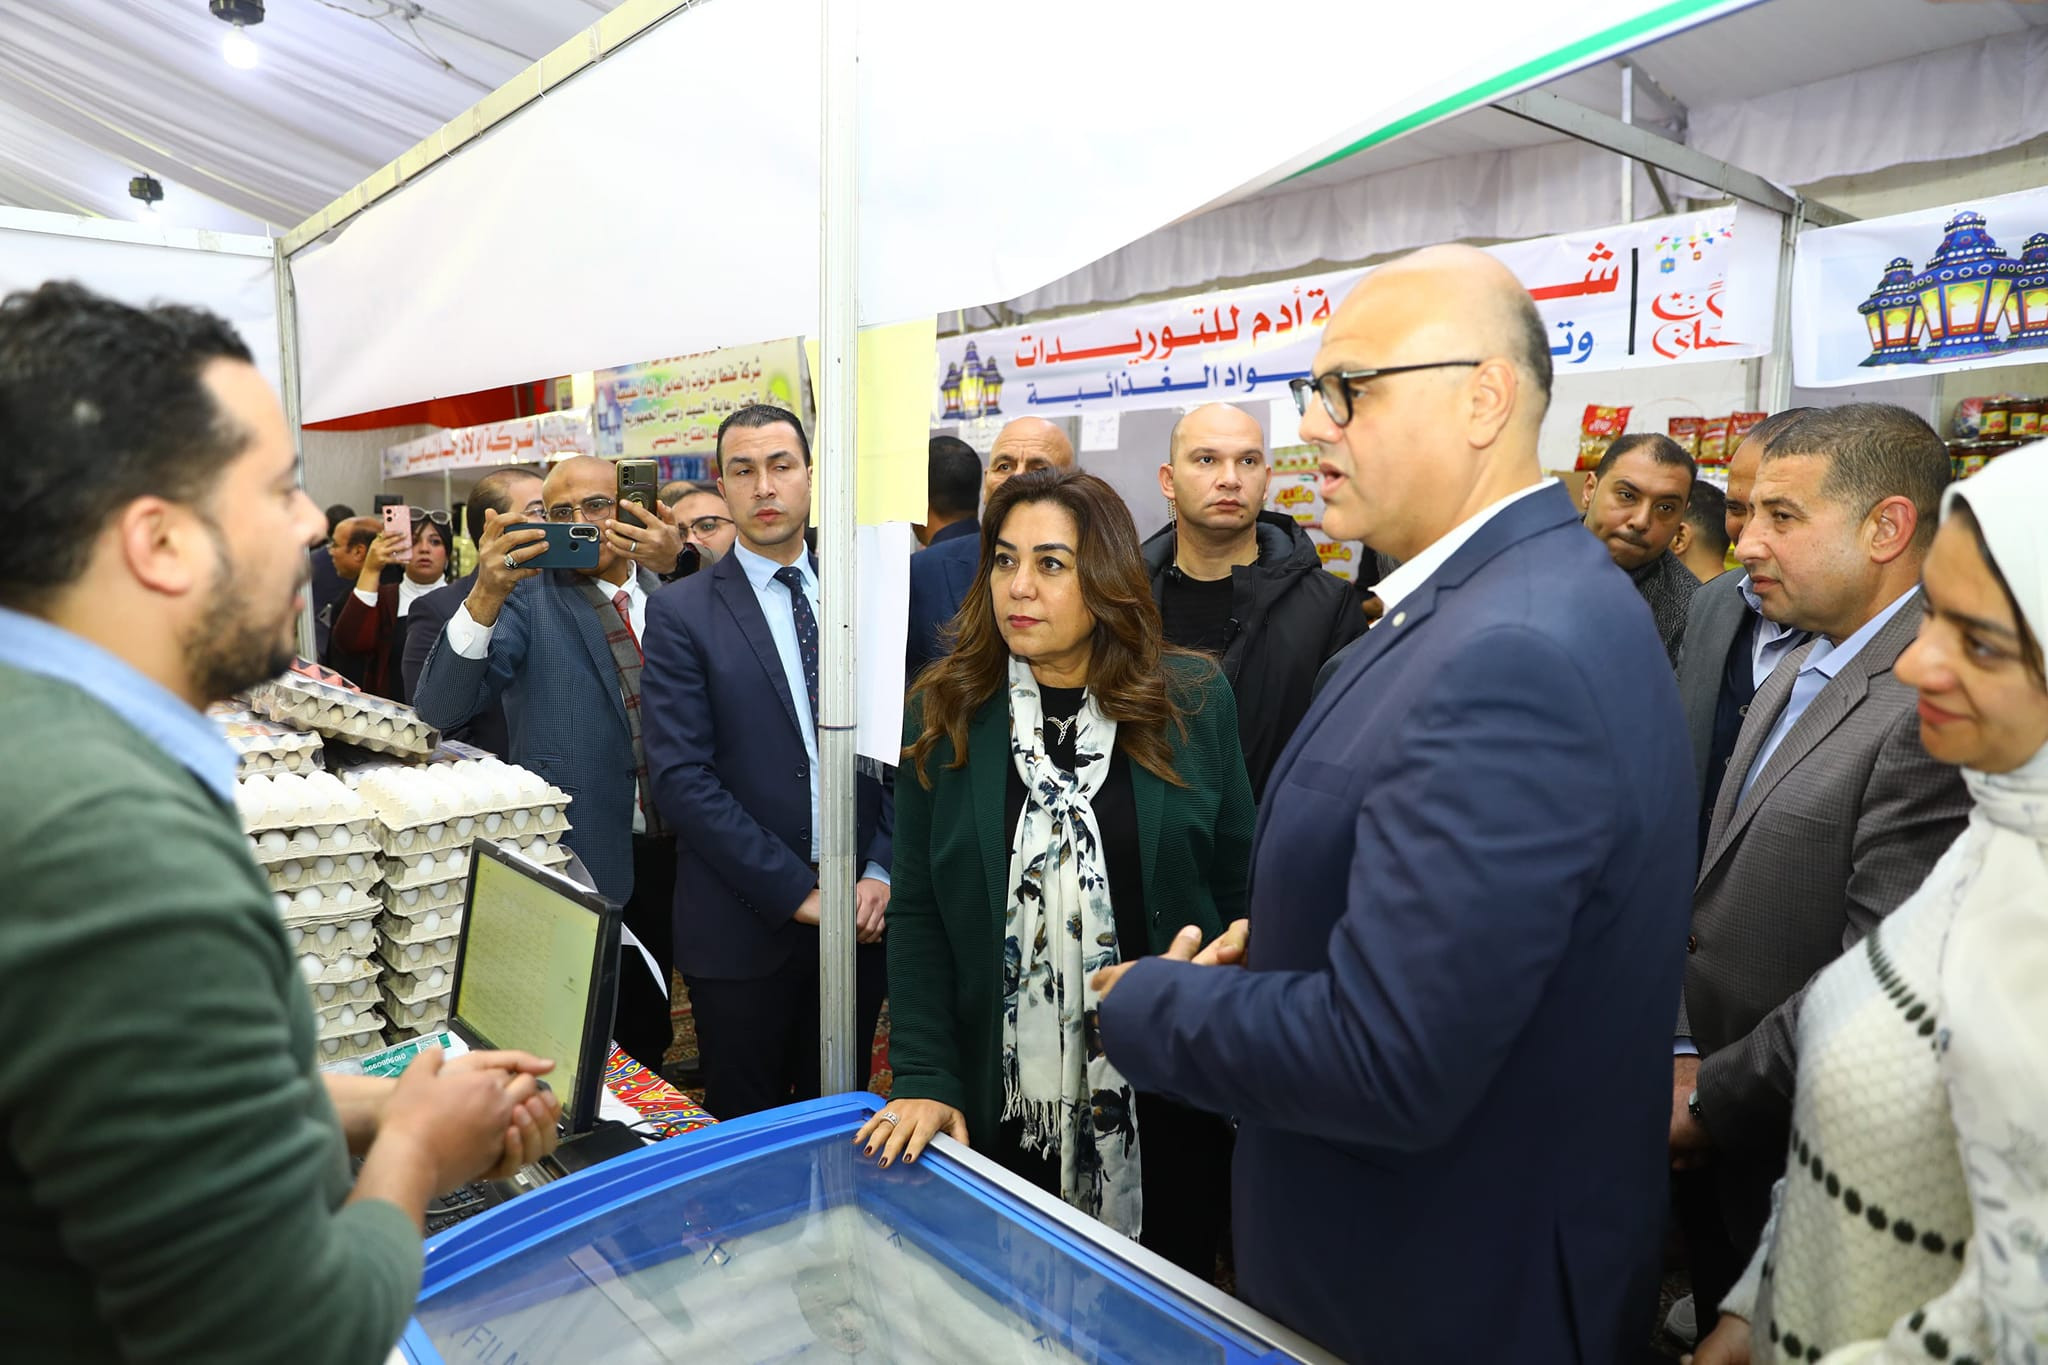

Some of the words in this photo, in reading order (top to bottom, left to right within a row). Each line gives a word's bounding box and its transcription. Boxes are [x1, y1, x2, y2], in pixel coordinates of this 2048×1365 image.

[1015, 302, 1240, 366] للتوريدات
[1252, 286, 1303, 346] أدم
[1026, 362, 1219, 408] الغذائية
[1225, 360, 1313, 388] واد
[686, 402, 709, 418] السيد
[487, 421, 535, 456] شركة
